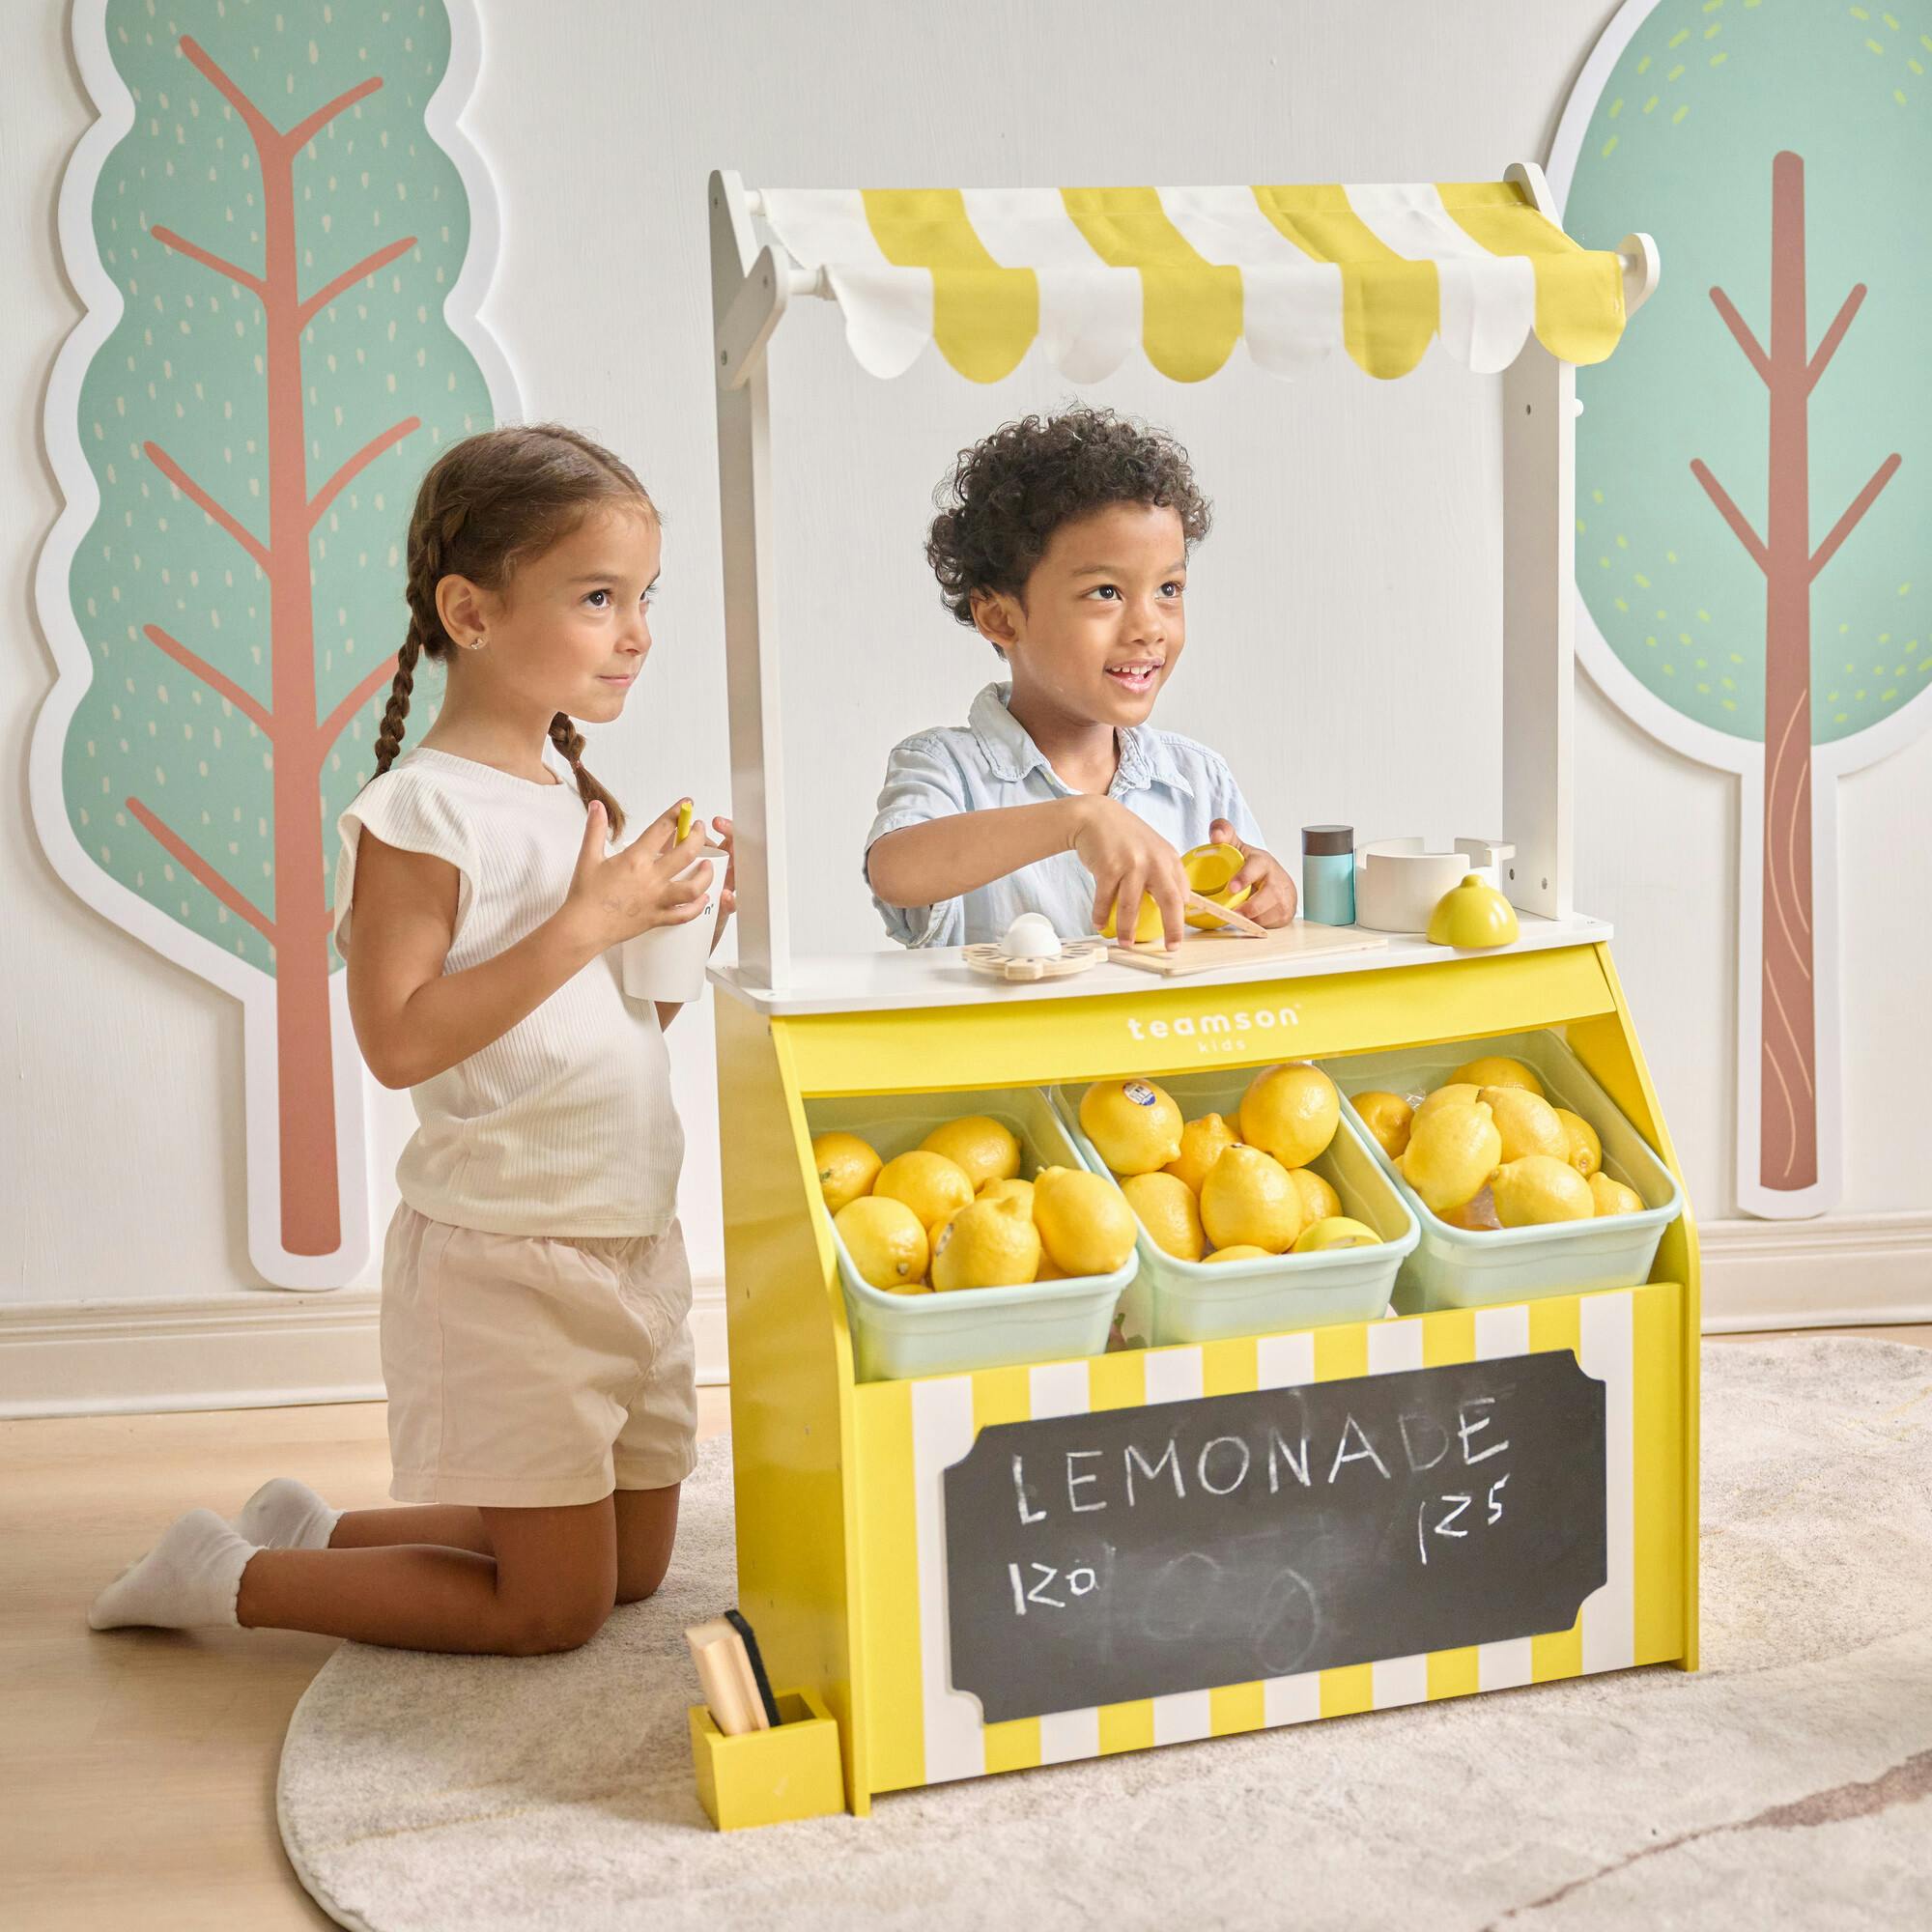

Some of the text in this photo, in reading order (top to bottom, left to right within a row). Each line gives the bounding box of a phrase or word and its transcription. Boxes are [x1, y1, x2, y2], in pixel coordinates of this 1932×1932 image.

[1127, 1007, 1299, 1040] teamson
[1198, 1039, 1246, 1053] kids
[1012, 1397, 1510, 1525] LEMONADE
